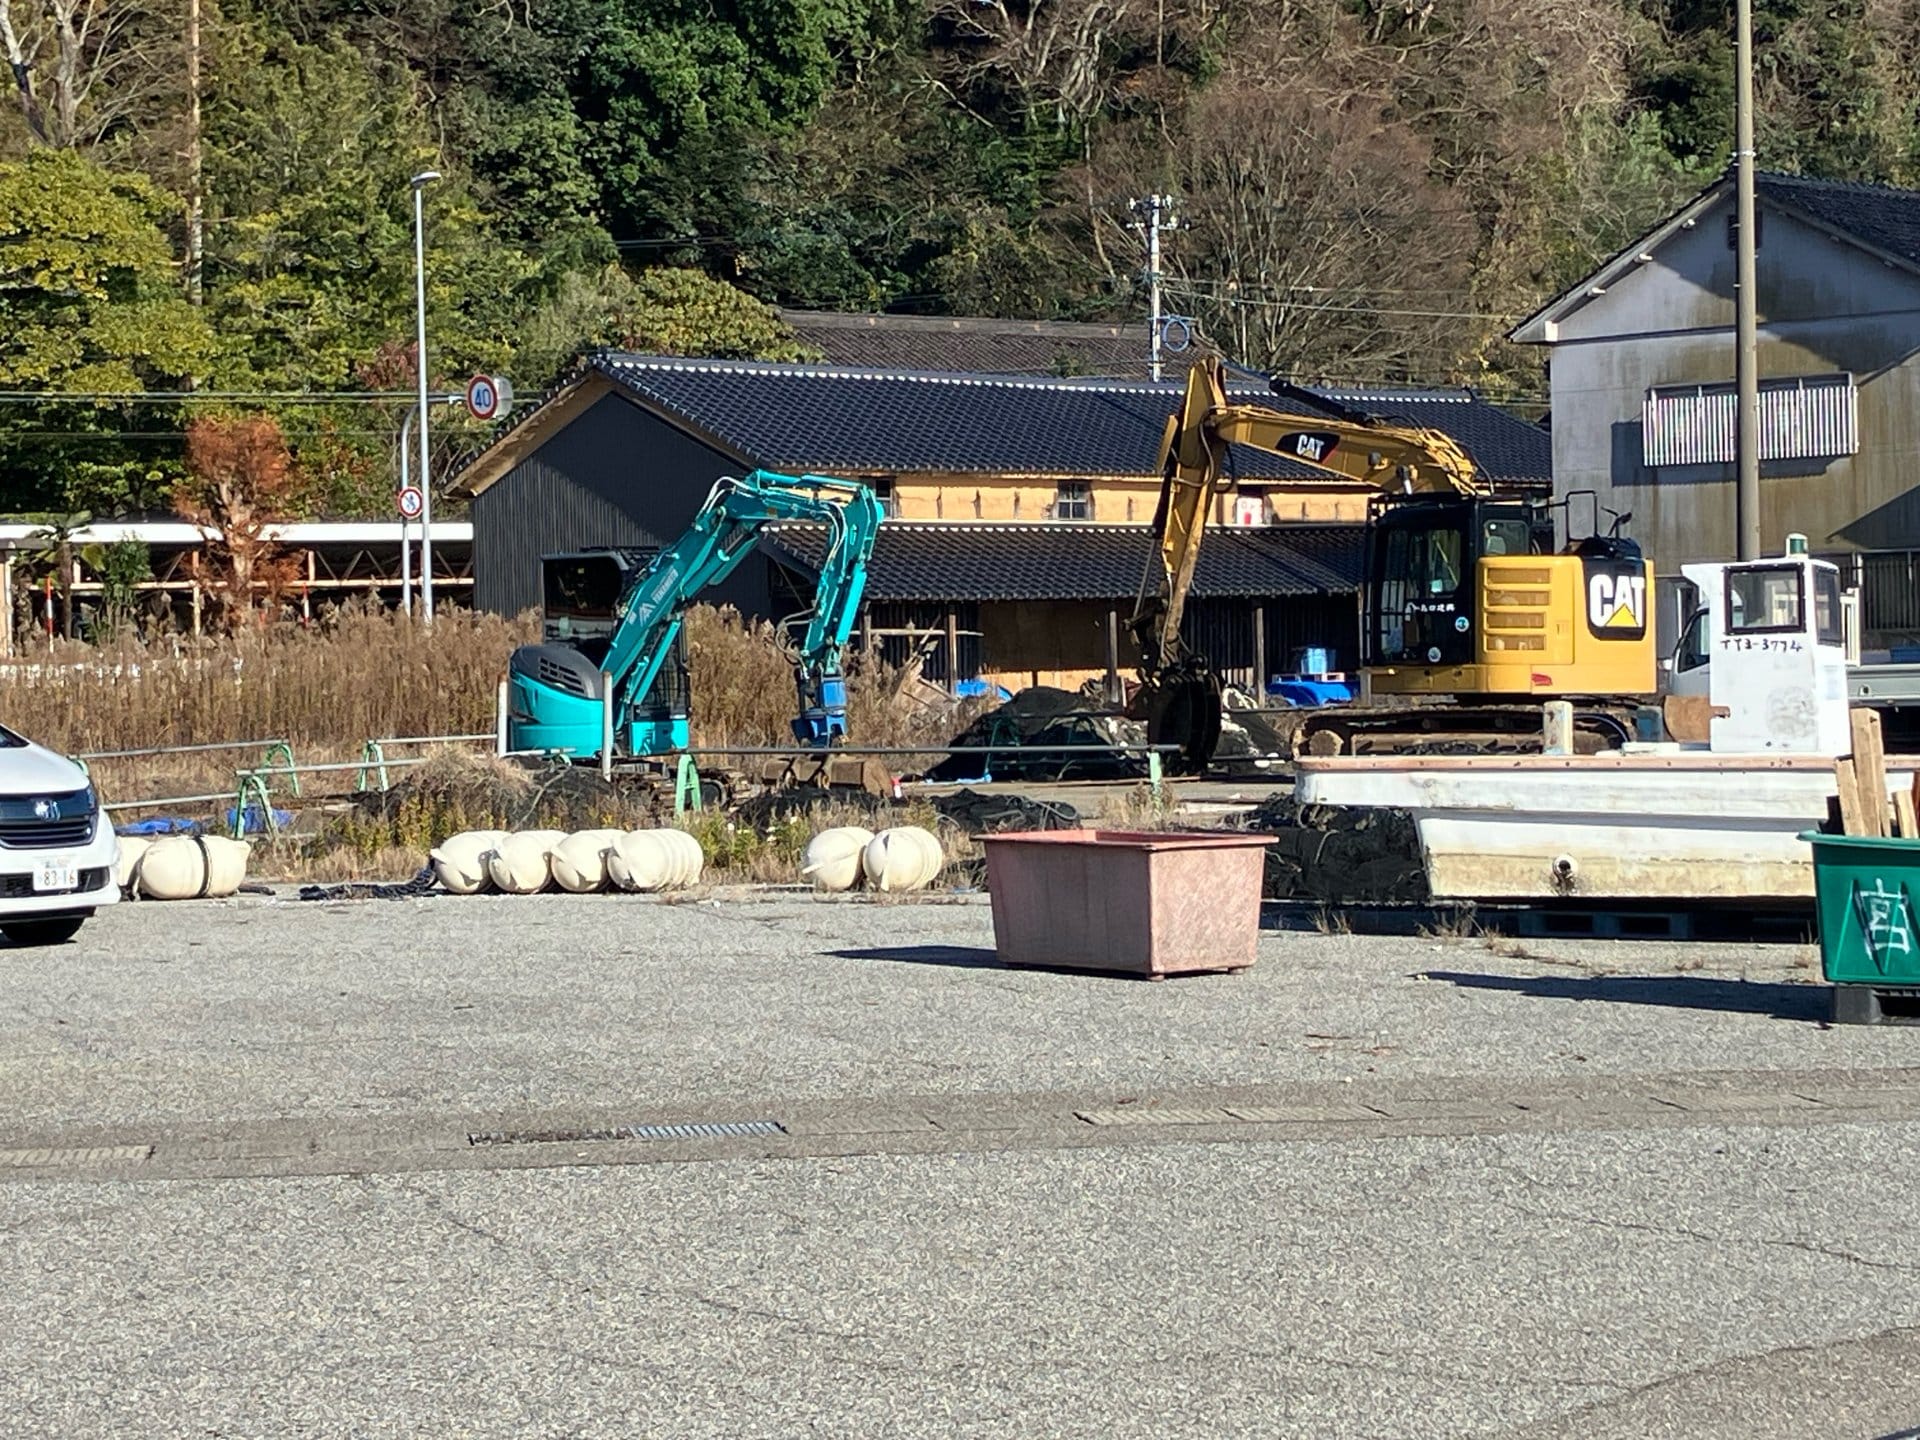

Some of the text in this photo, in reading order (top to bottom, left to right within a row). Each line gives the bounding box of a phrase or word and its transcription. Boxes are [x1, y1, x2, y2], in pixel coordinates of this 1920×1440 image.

[474, 387, 492, 408] 40
[1296, 434, 1325, 461] CAT
[1589, 573, 1645, 628] CAT
